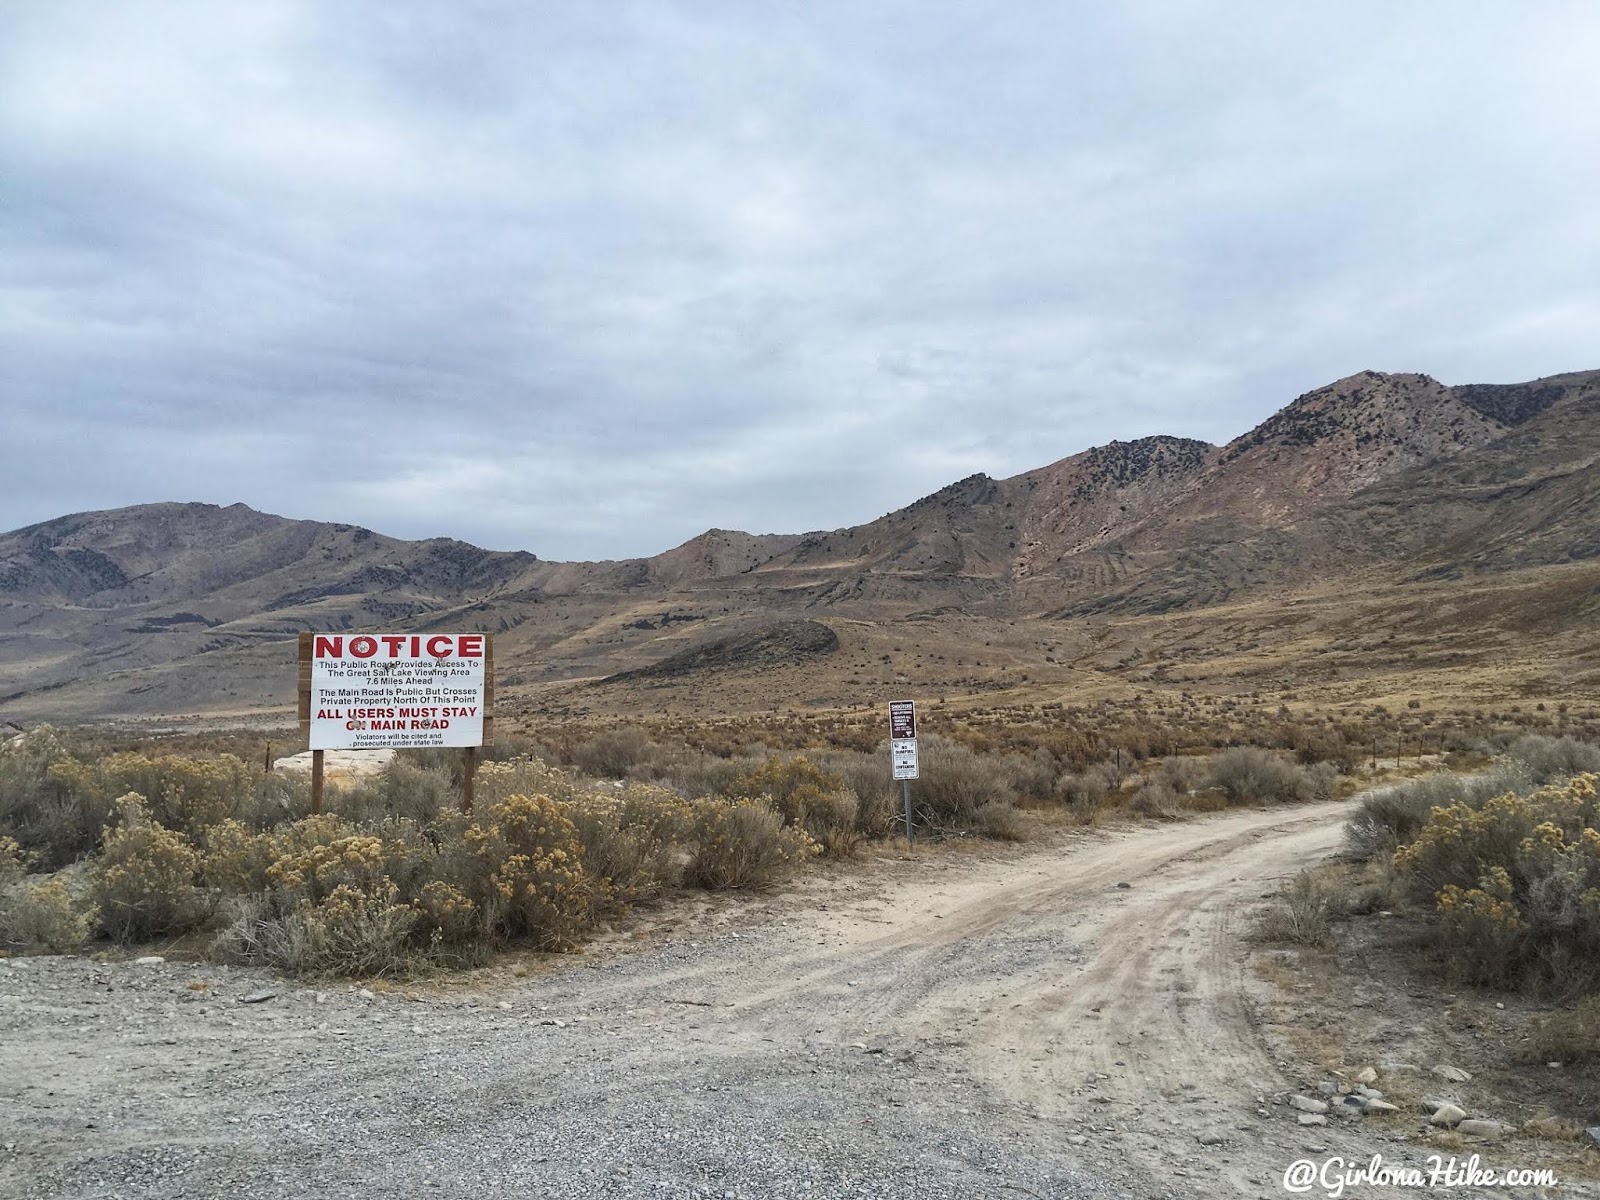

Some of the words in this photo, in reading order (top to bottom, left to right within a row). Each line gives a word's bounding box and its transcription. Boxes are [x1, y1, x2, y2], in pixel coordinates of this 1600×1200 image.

[316, 636, 482, 658] NOTICE
[415, 669, 448, 677] Viewing
[386, 688, 394, 696] Is
[354, 697, 391, 706] Property
[317, 709, 343, 719] ALL
[348, 708, 394, 718] USERS
[399, 708, 438, 718] MUST
[442, 707, 477, 717] STAY
[371, 720, 405, 730] MAIN
[411, 719, 449, 730] ROAD
